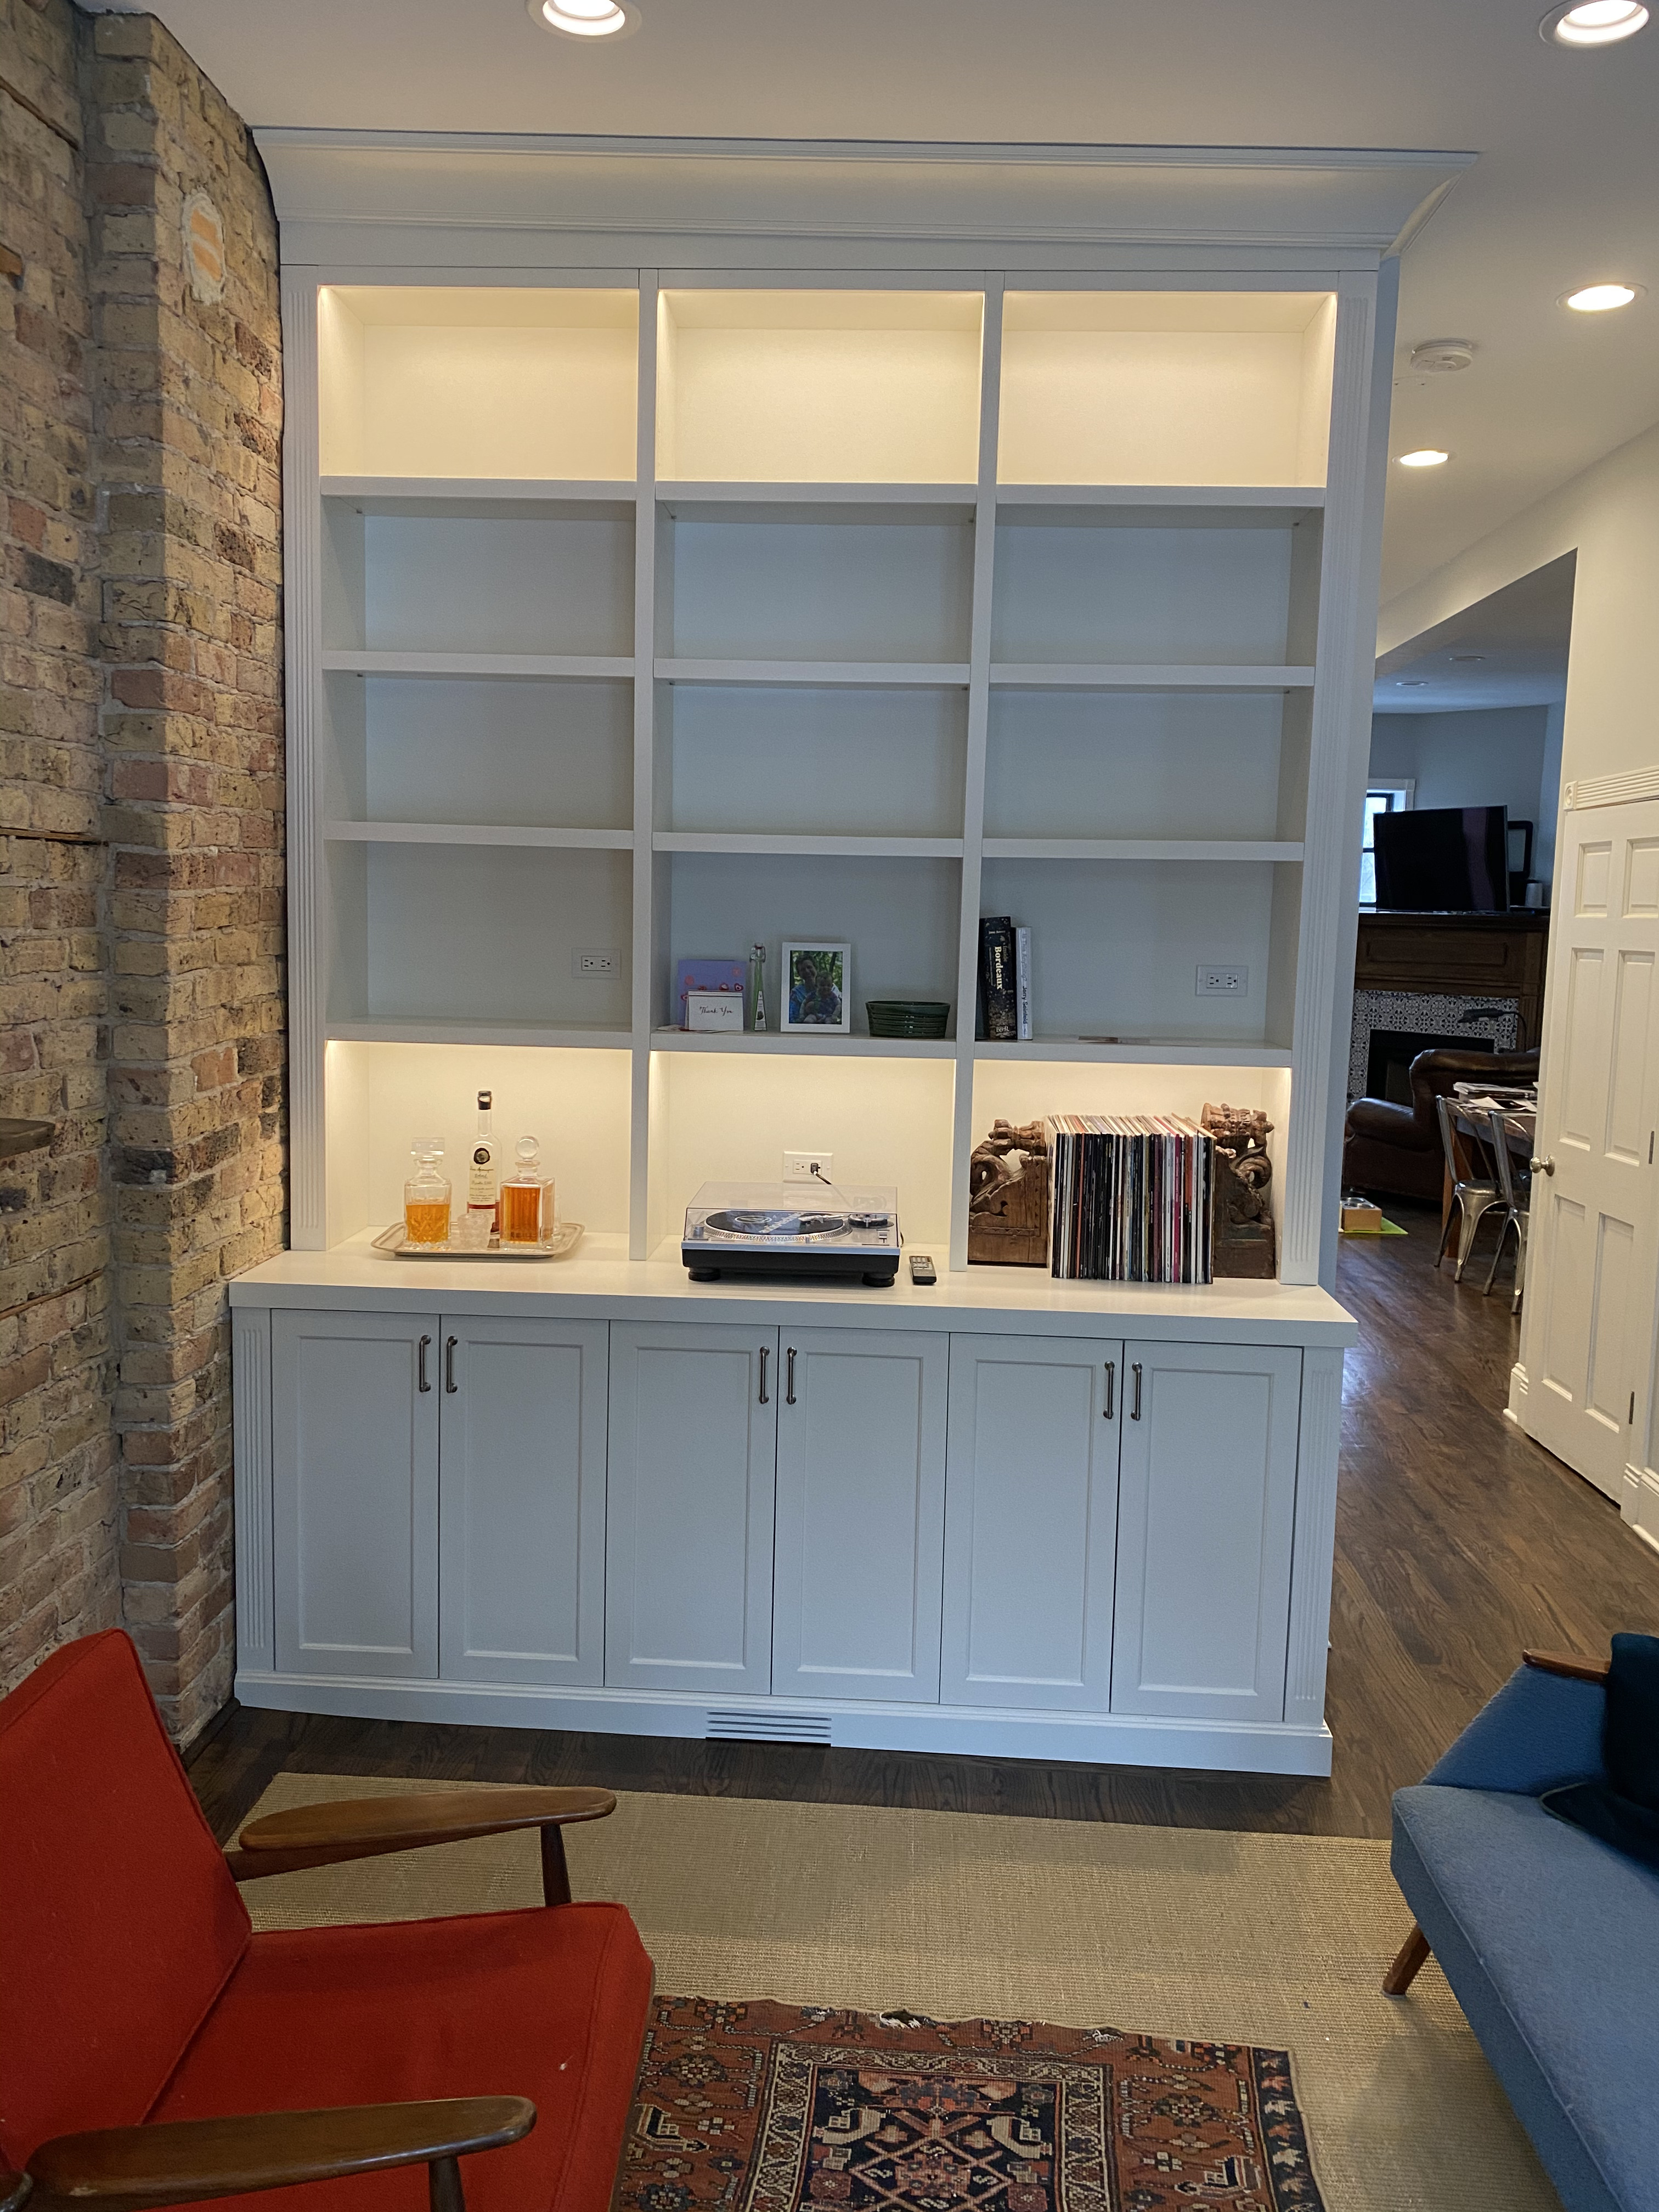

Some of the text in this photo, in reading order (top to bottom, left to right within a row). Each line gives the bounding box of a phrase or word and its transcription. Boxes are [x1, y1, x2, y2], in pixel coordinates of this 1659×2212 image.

[995, 946, 1003, 990] Bordeaux
[699, 1006, 733, 1017] Thank You
